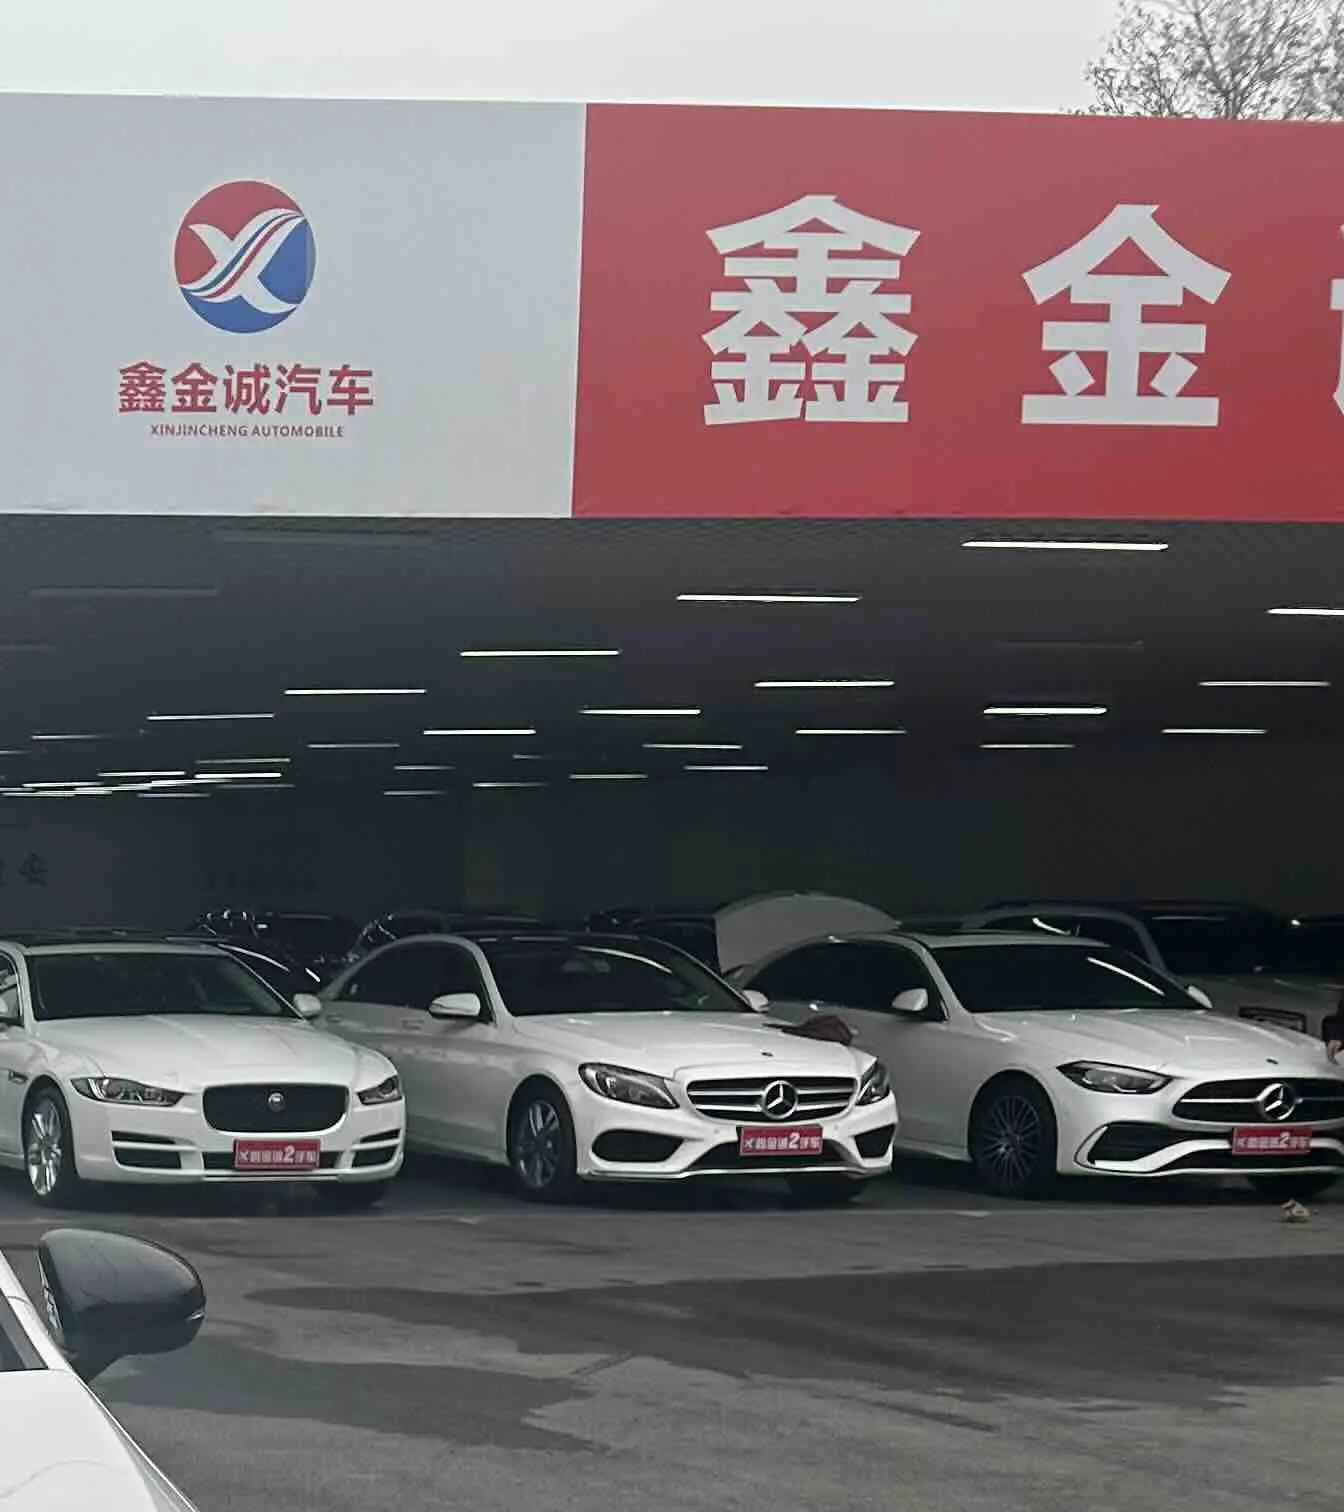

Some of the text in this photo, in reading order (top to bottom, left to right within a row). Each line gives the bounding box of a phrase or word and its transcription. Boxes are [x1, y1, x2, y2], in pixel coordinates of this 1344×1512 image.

[702, 194, 1344, 428] 鑫金
[118, 360, 375, 416] 鑫金诚汽车
[150, 423, 345, 438] XINJINCHENG AUTOMOBILE
